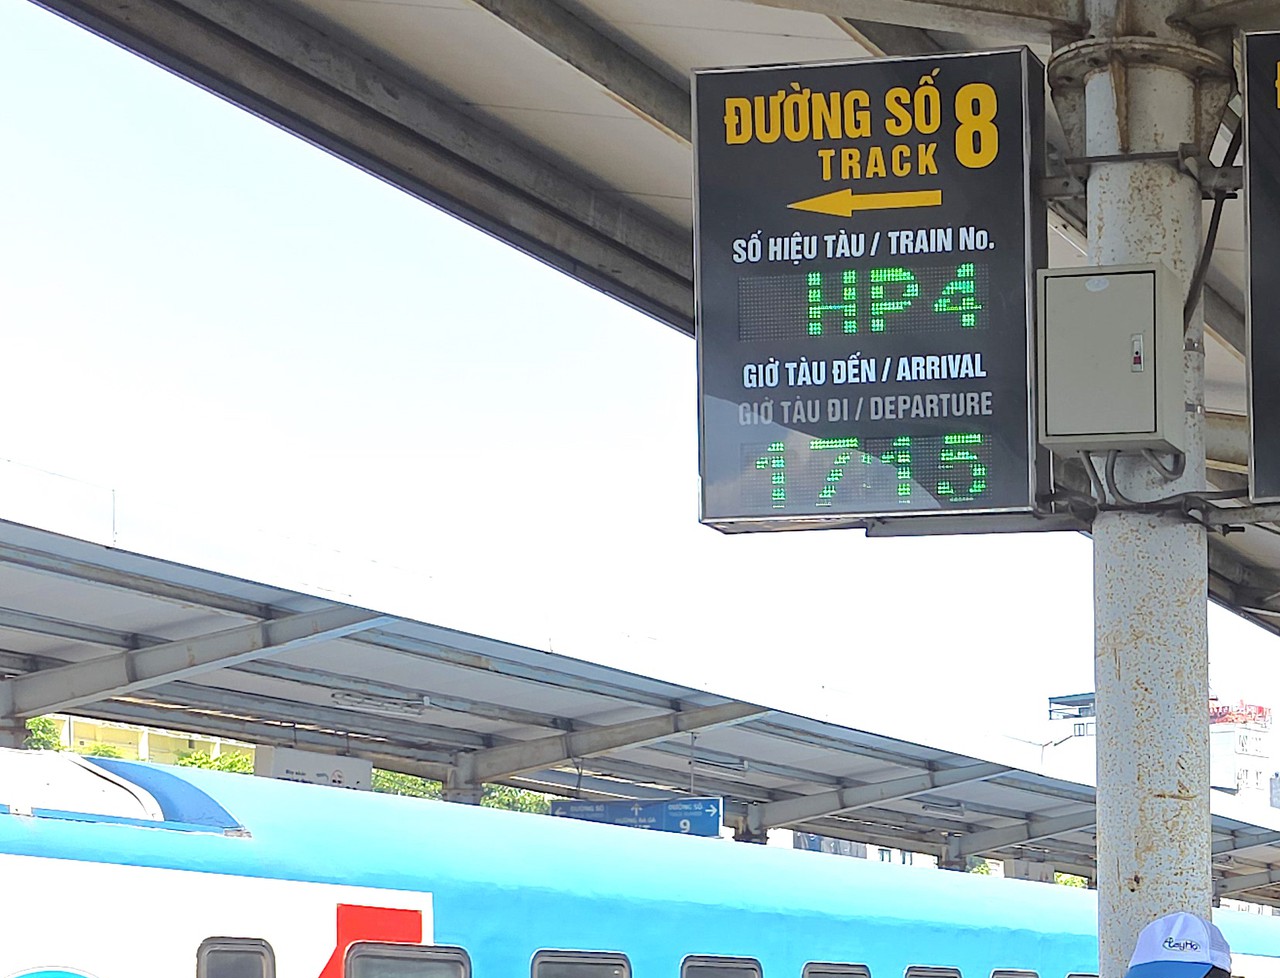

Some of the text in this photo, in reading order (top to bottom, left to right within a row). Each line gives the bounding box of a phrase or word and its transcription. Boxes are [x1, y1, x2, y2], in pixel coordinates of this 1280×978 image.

[724, 67, 999, 169] ĐƯỜNG SỐ 8
[818, 143, 938, 181] TRACK
[732, 229, 764, 263] SỐ
[768, 231, 819, 267] HIỆU
[823, 229, 867, 258] TÀU
[889, 228, 955, 255] TRAIN
[958, 226, 996, 252] No.
[805, 262, 985, 338] HP4
[741, 361, 782, 389] GIỜ
[784, 357, 829, 387] TÀU
[831, 353, 878, 384] ĐẾN
[895, 353, 987, 382] ARRIVAL
[737, 398, 778, 427] GIỜ
[780, 395, 826, 424] TÀU
[829, 397, 853, 422] ĐI
[869, 391, 993, 420] DEPARTURE
[679, 819, 691, 833] 9
